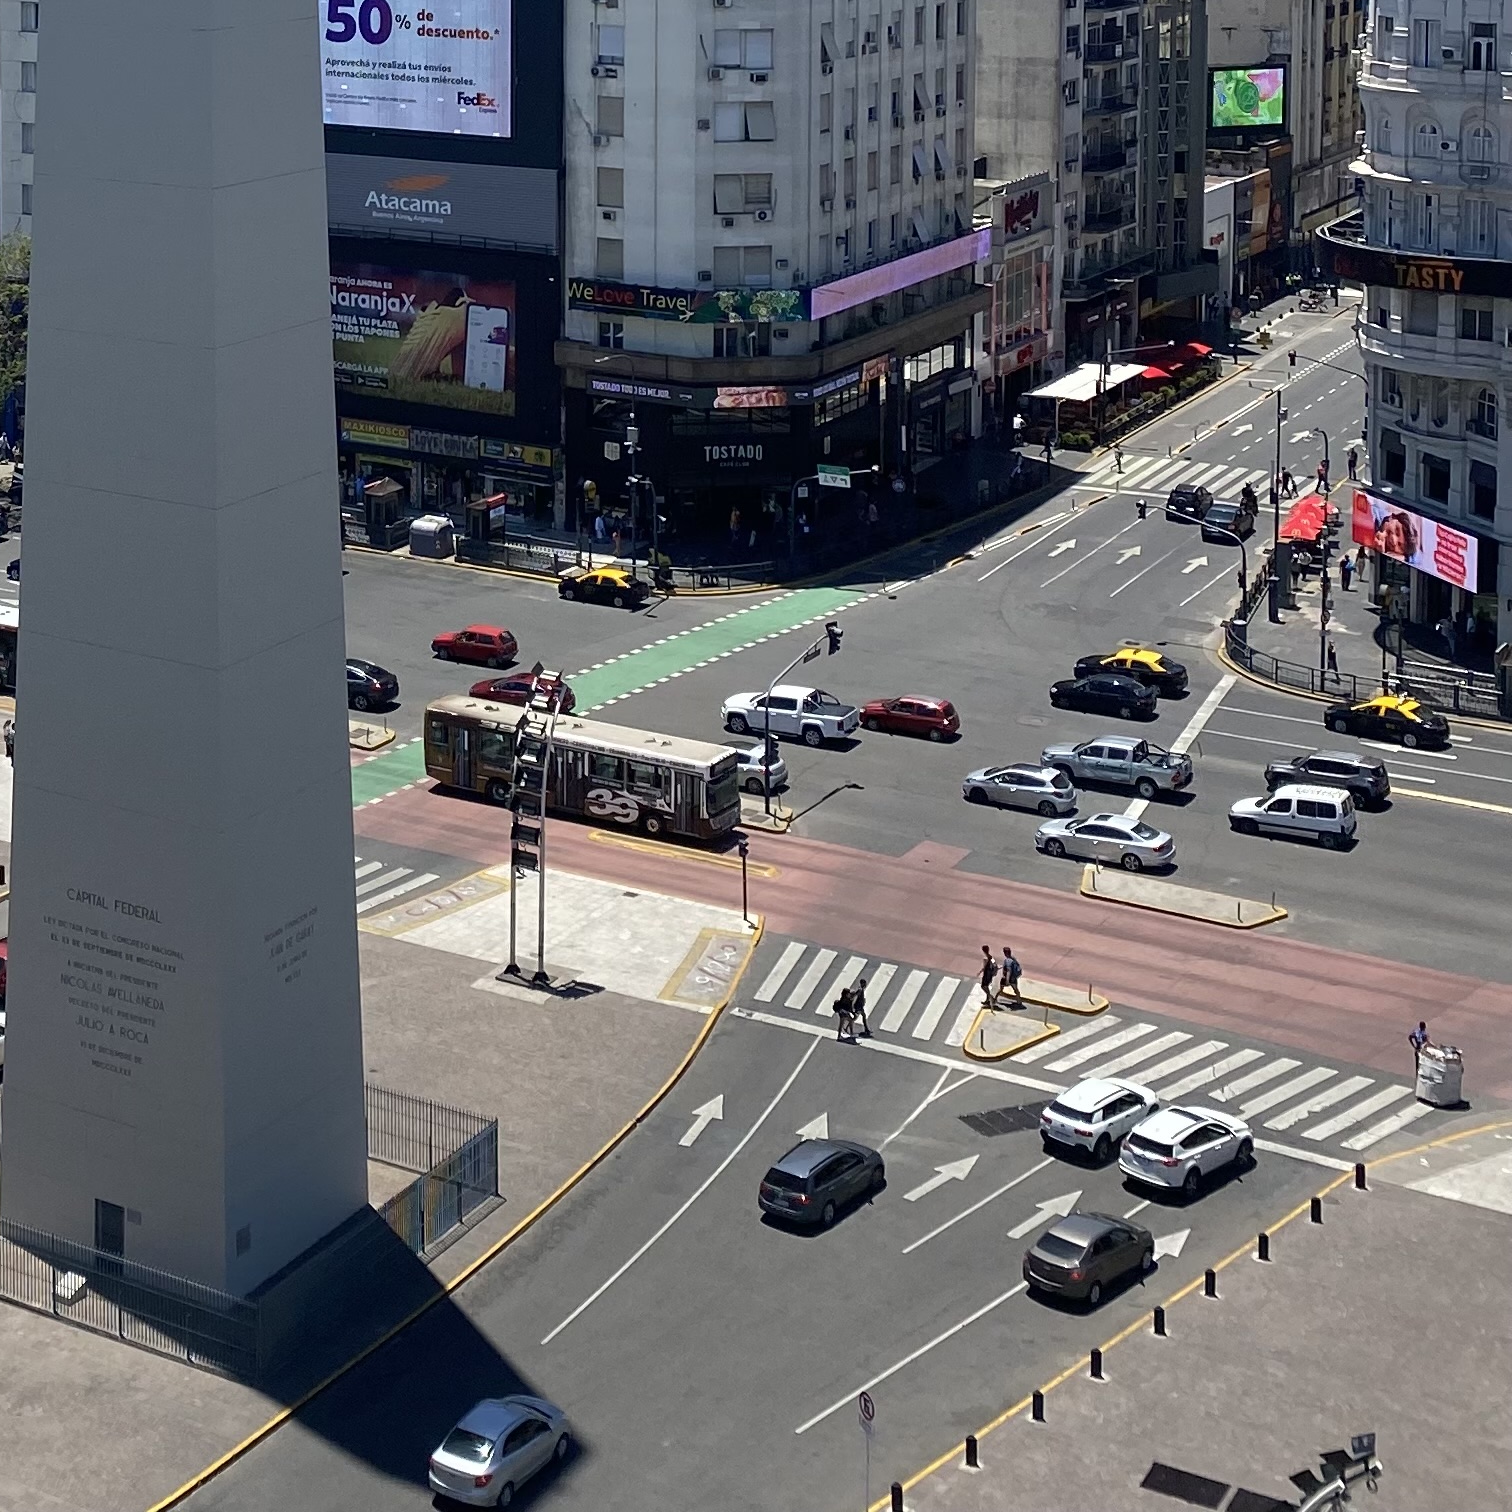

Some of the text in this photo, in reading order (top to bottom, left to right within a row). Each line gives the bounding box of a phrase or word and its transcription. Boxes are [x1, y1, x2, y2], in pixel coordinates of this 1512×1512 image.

[416, 9, 434, 22] de
[326, 57, 370, 71] Aprovechá
[371, 62, 377, 70] y
[378, 60, 406, 70] realizá
[408, 62, 422, 71] tus
[326, 70, 476, 86] internacionales todos los miércoles.
[457, 91, 496, 107] FedEx
[364, 190, 452, 215] Atacama
[330, 275, 393, 290] aranja AHORA ES
[1394, 264, 1464, 291] TASTY
[640, 289, 691, 311] Travel
[331, 314, 398, 330] ANEJÁ TU PLATA
[333, 360, 363, 372] SCARGA
[592, 380, 620, 392] TOSTADO
[343, 420, 406, 438] MAXIKIOSCO
[704, 444, 763, 462] TOSTADO
[586, 788, 639, 824] 39
[66, 888, 162, 924] CAPITAL FEDERAL
[60, 973, 166, 1012] NICOLAS AVELLANEDA
[75, 1015, 149, 1044] JULIO A ROCA
